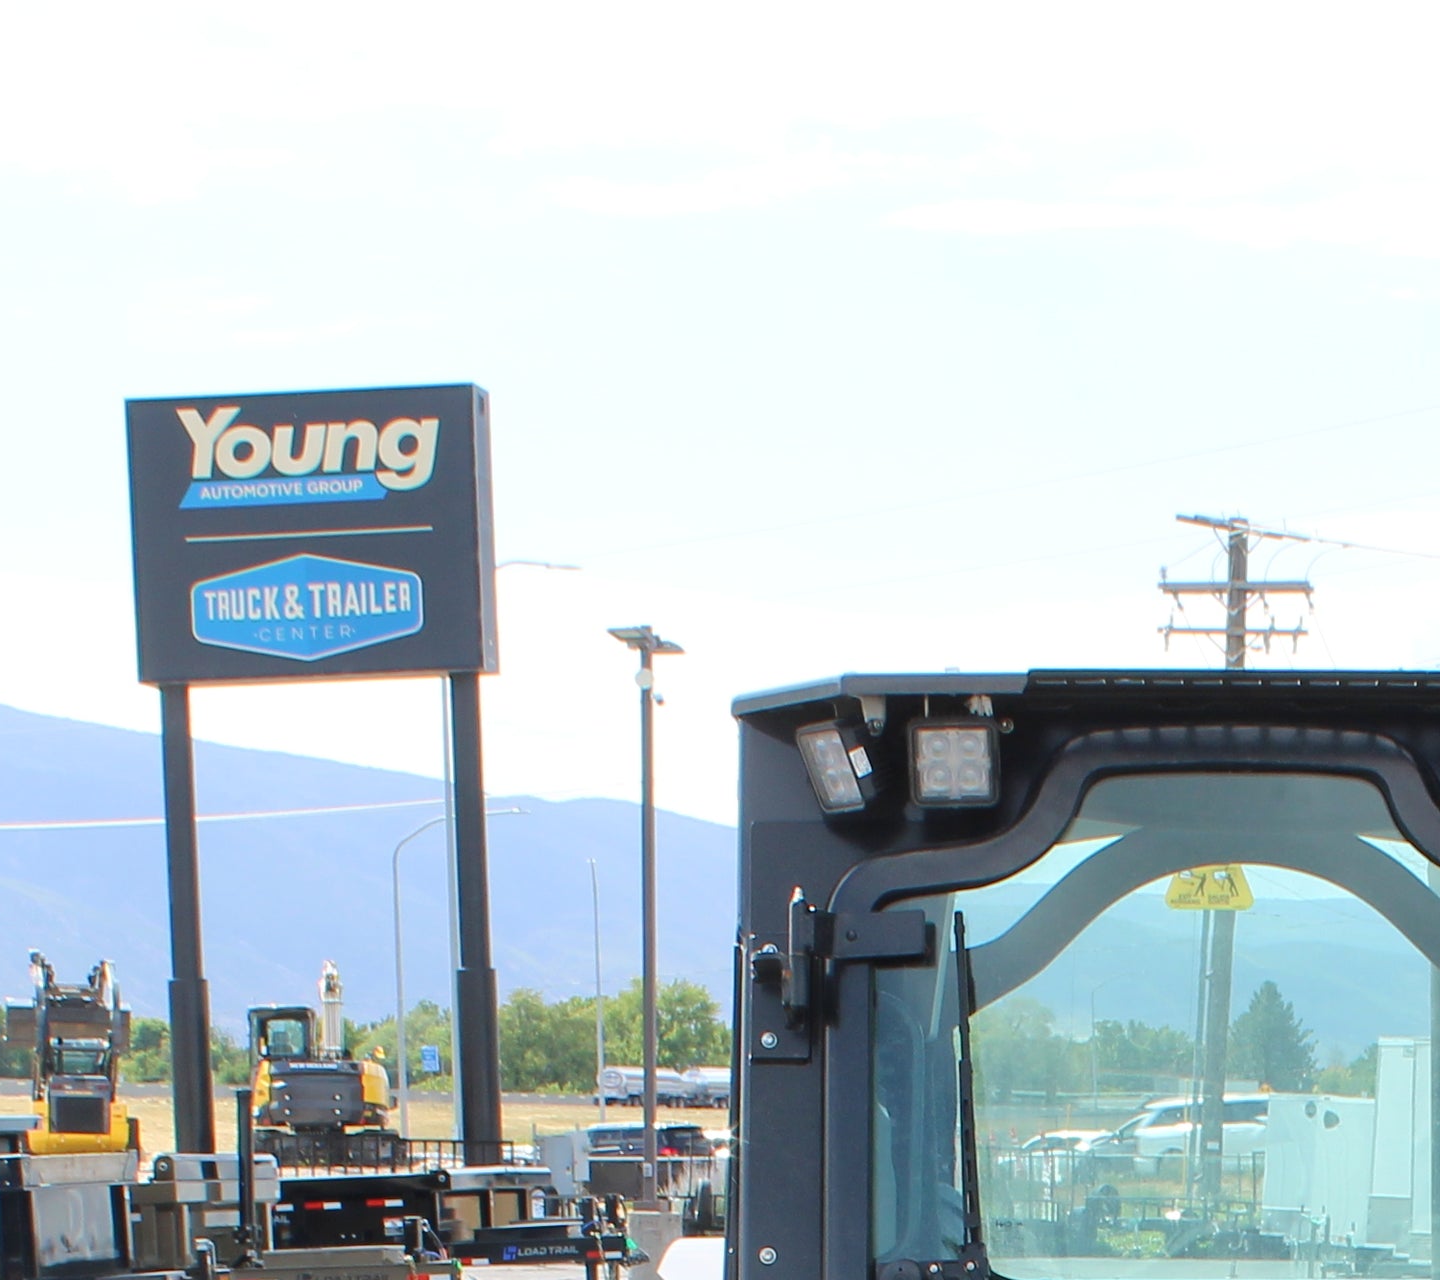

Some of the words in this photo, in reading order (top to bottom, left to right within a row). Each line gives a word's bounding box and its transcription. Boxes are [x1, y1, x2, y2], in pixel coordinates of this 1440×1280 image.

[176, 406, 440, 491] Young
[200, 481, 304, 501] AUTOMOTIVE
[307, 479, 363, 496] GROUP
[204, 586, 281, 621] TRUCK
[283, 584, 305, 620] &
[309, 581, 412, 620] TRAILER
[259, 624, 353, 642] CENTER
[517, 1247, 547, 1257] LOAD
[548, 1244, 580, 1255] TRAIL
